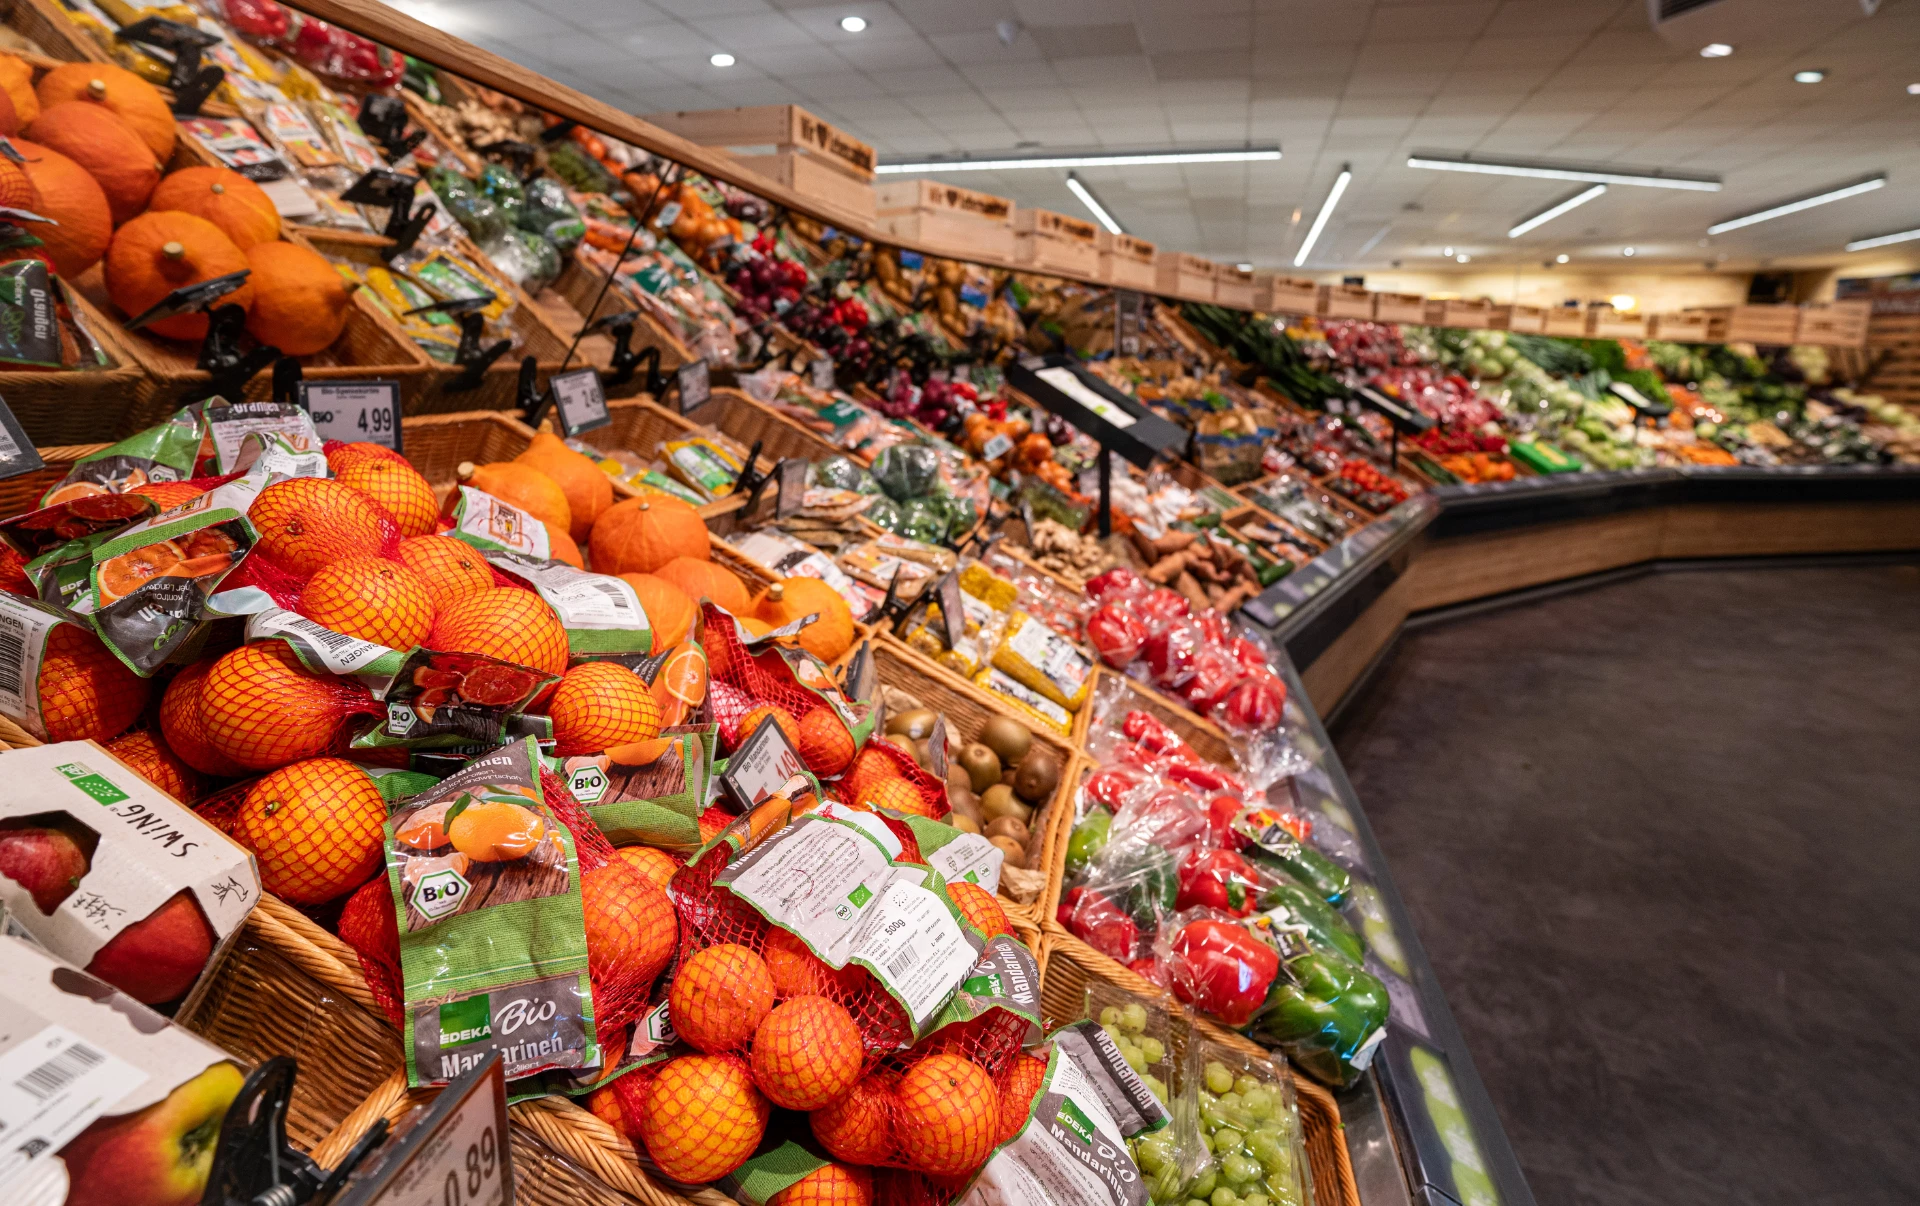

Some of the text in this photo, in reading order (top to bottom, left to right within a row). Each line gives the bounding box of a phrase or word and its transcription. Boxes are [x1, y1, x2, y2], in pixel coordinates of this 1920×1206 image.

[884, 916, 906, 939] 500g
[439, 997, 557, 1045] EDEKA Bio
[440, 1036, 563, 1078] Manarinen
[1056, 1111, 1094, 1143] EDEKA
[1050, 1123, 1130, 1206] Mandarinen
